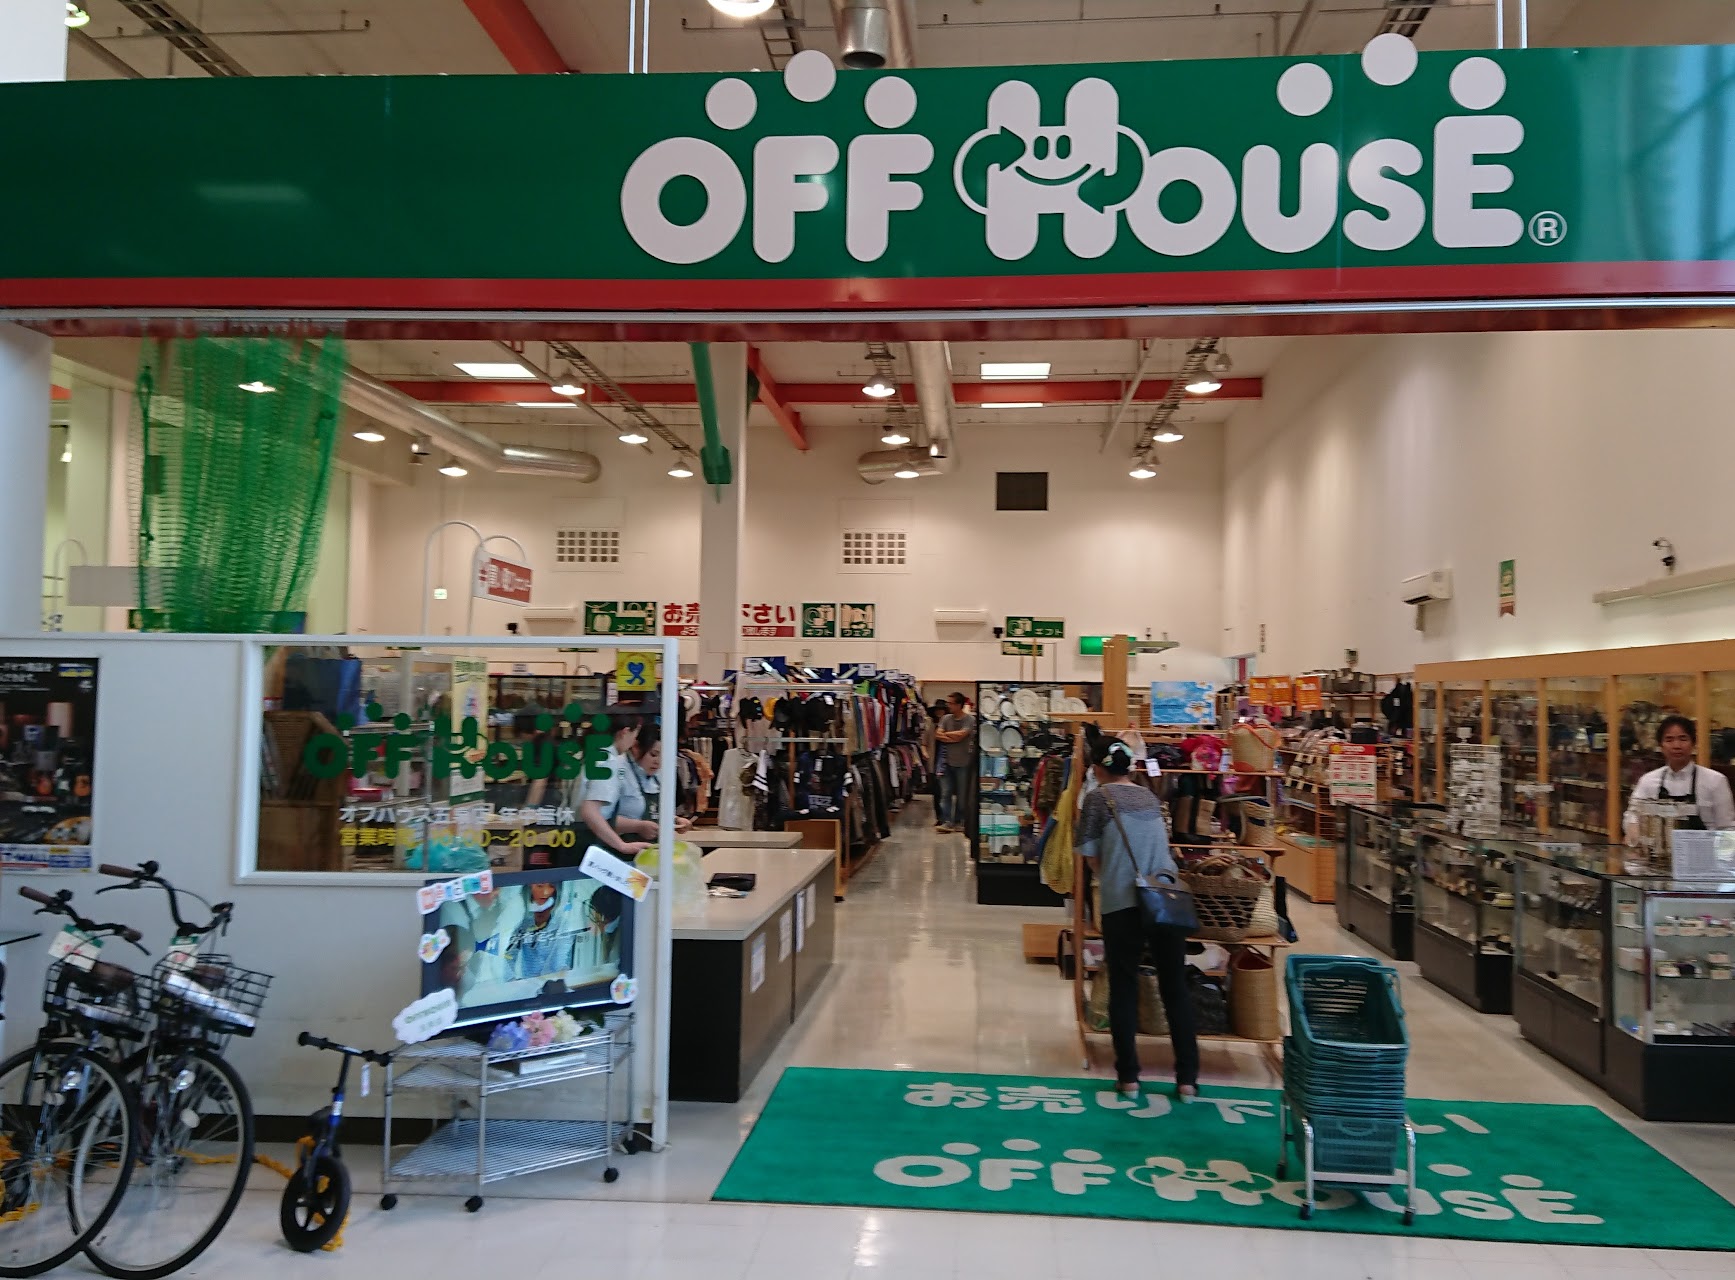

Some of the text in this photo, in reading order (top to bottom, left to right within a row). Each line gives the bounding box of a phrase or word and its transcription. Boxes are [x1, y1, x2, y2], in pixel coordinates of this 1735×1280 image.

[620, 50, 934, 264] OFF
[955, 33, 1525, 260] HOUSE
[662, 602, 796, 625] お売さい
[303, 702, 613, 781] OFF HOUSE
[904, 1082, 1491, 1134] お売り下い
[873, 1138, 1116, 1196] OFF
